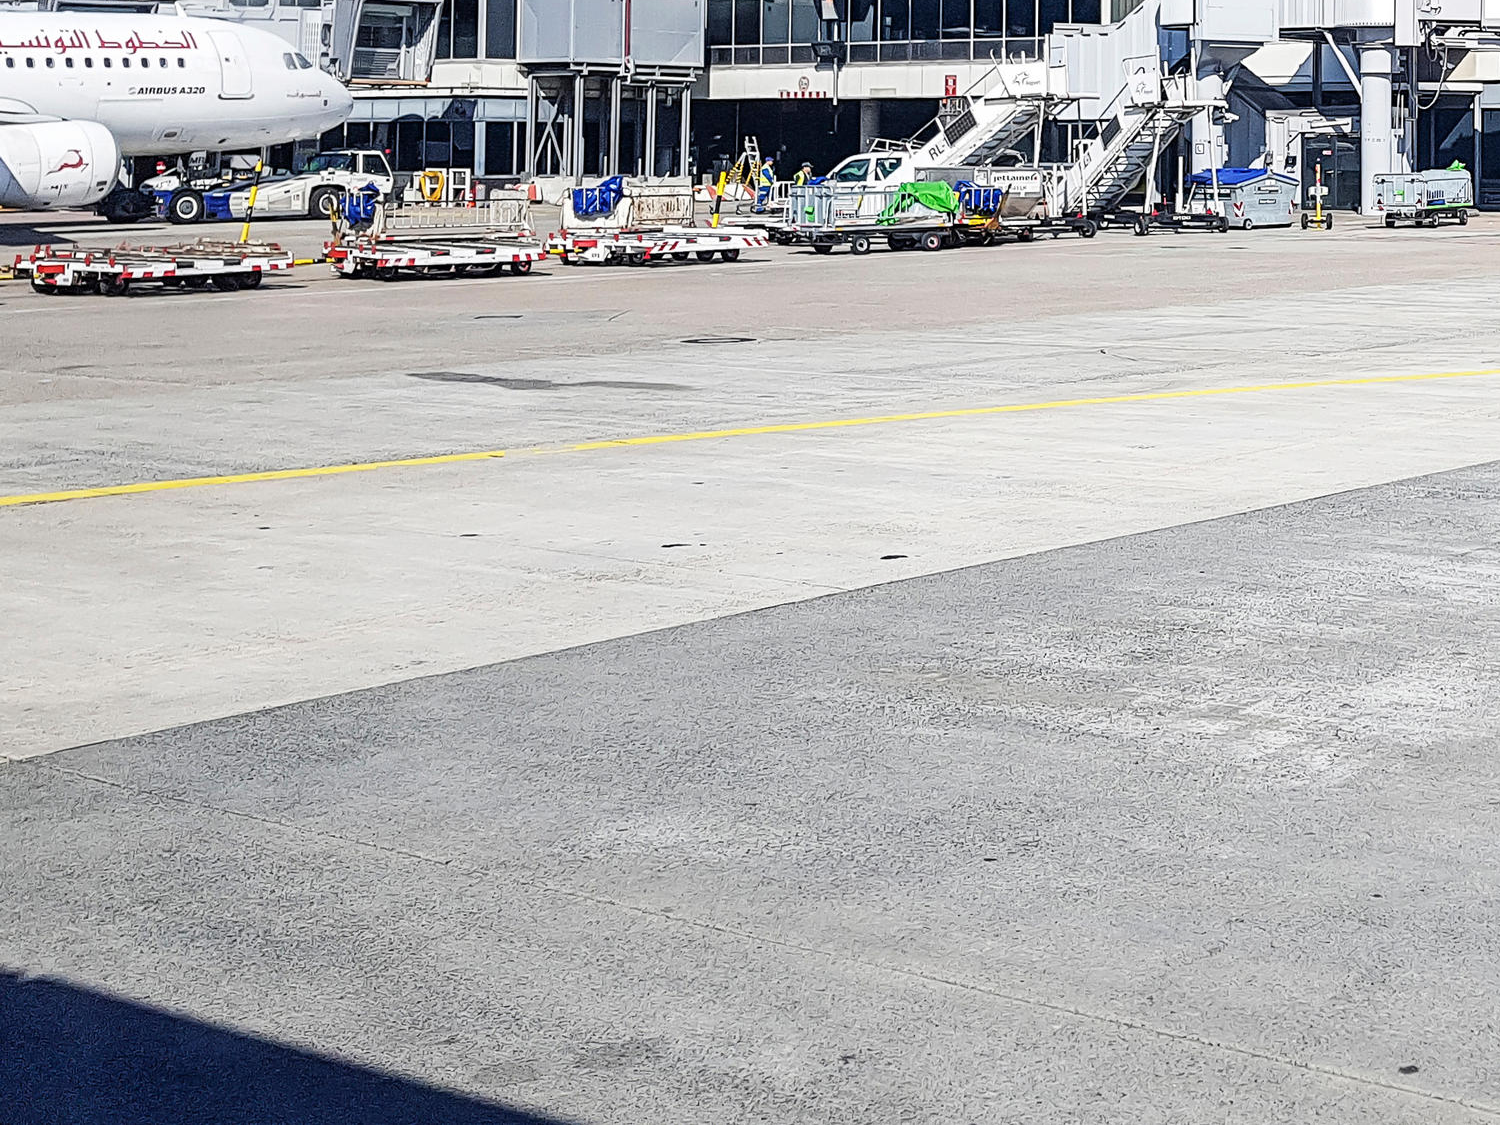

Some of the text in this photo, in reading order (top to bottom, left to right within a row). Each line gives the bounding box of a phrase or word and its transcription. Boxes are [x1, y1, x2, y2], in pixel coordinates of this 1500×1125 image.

[0, 29, 198, 55] الخطوط التونسي
[137, 87, 206, 95] AIRBUS A320
